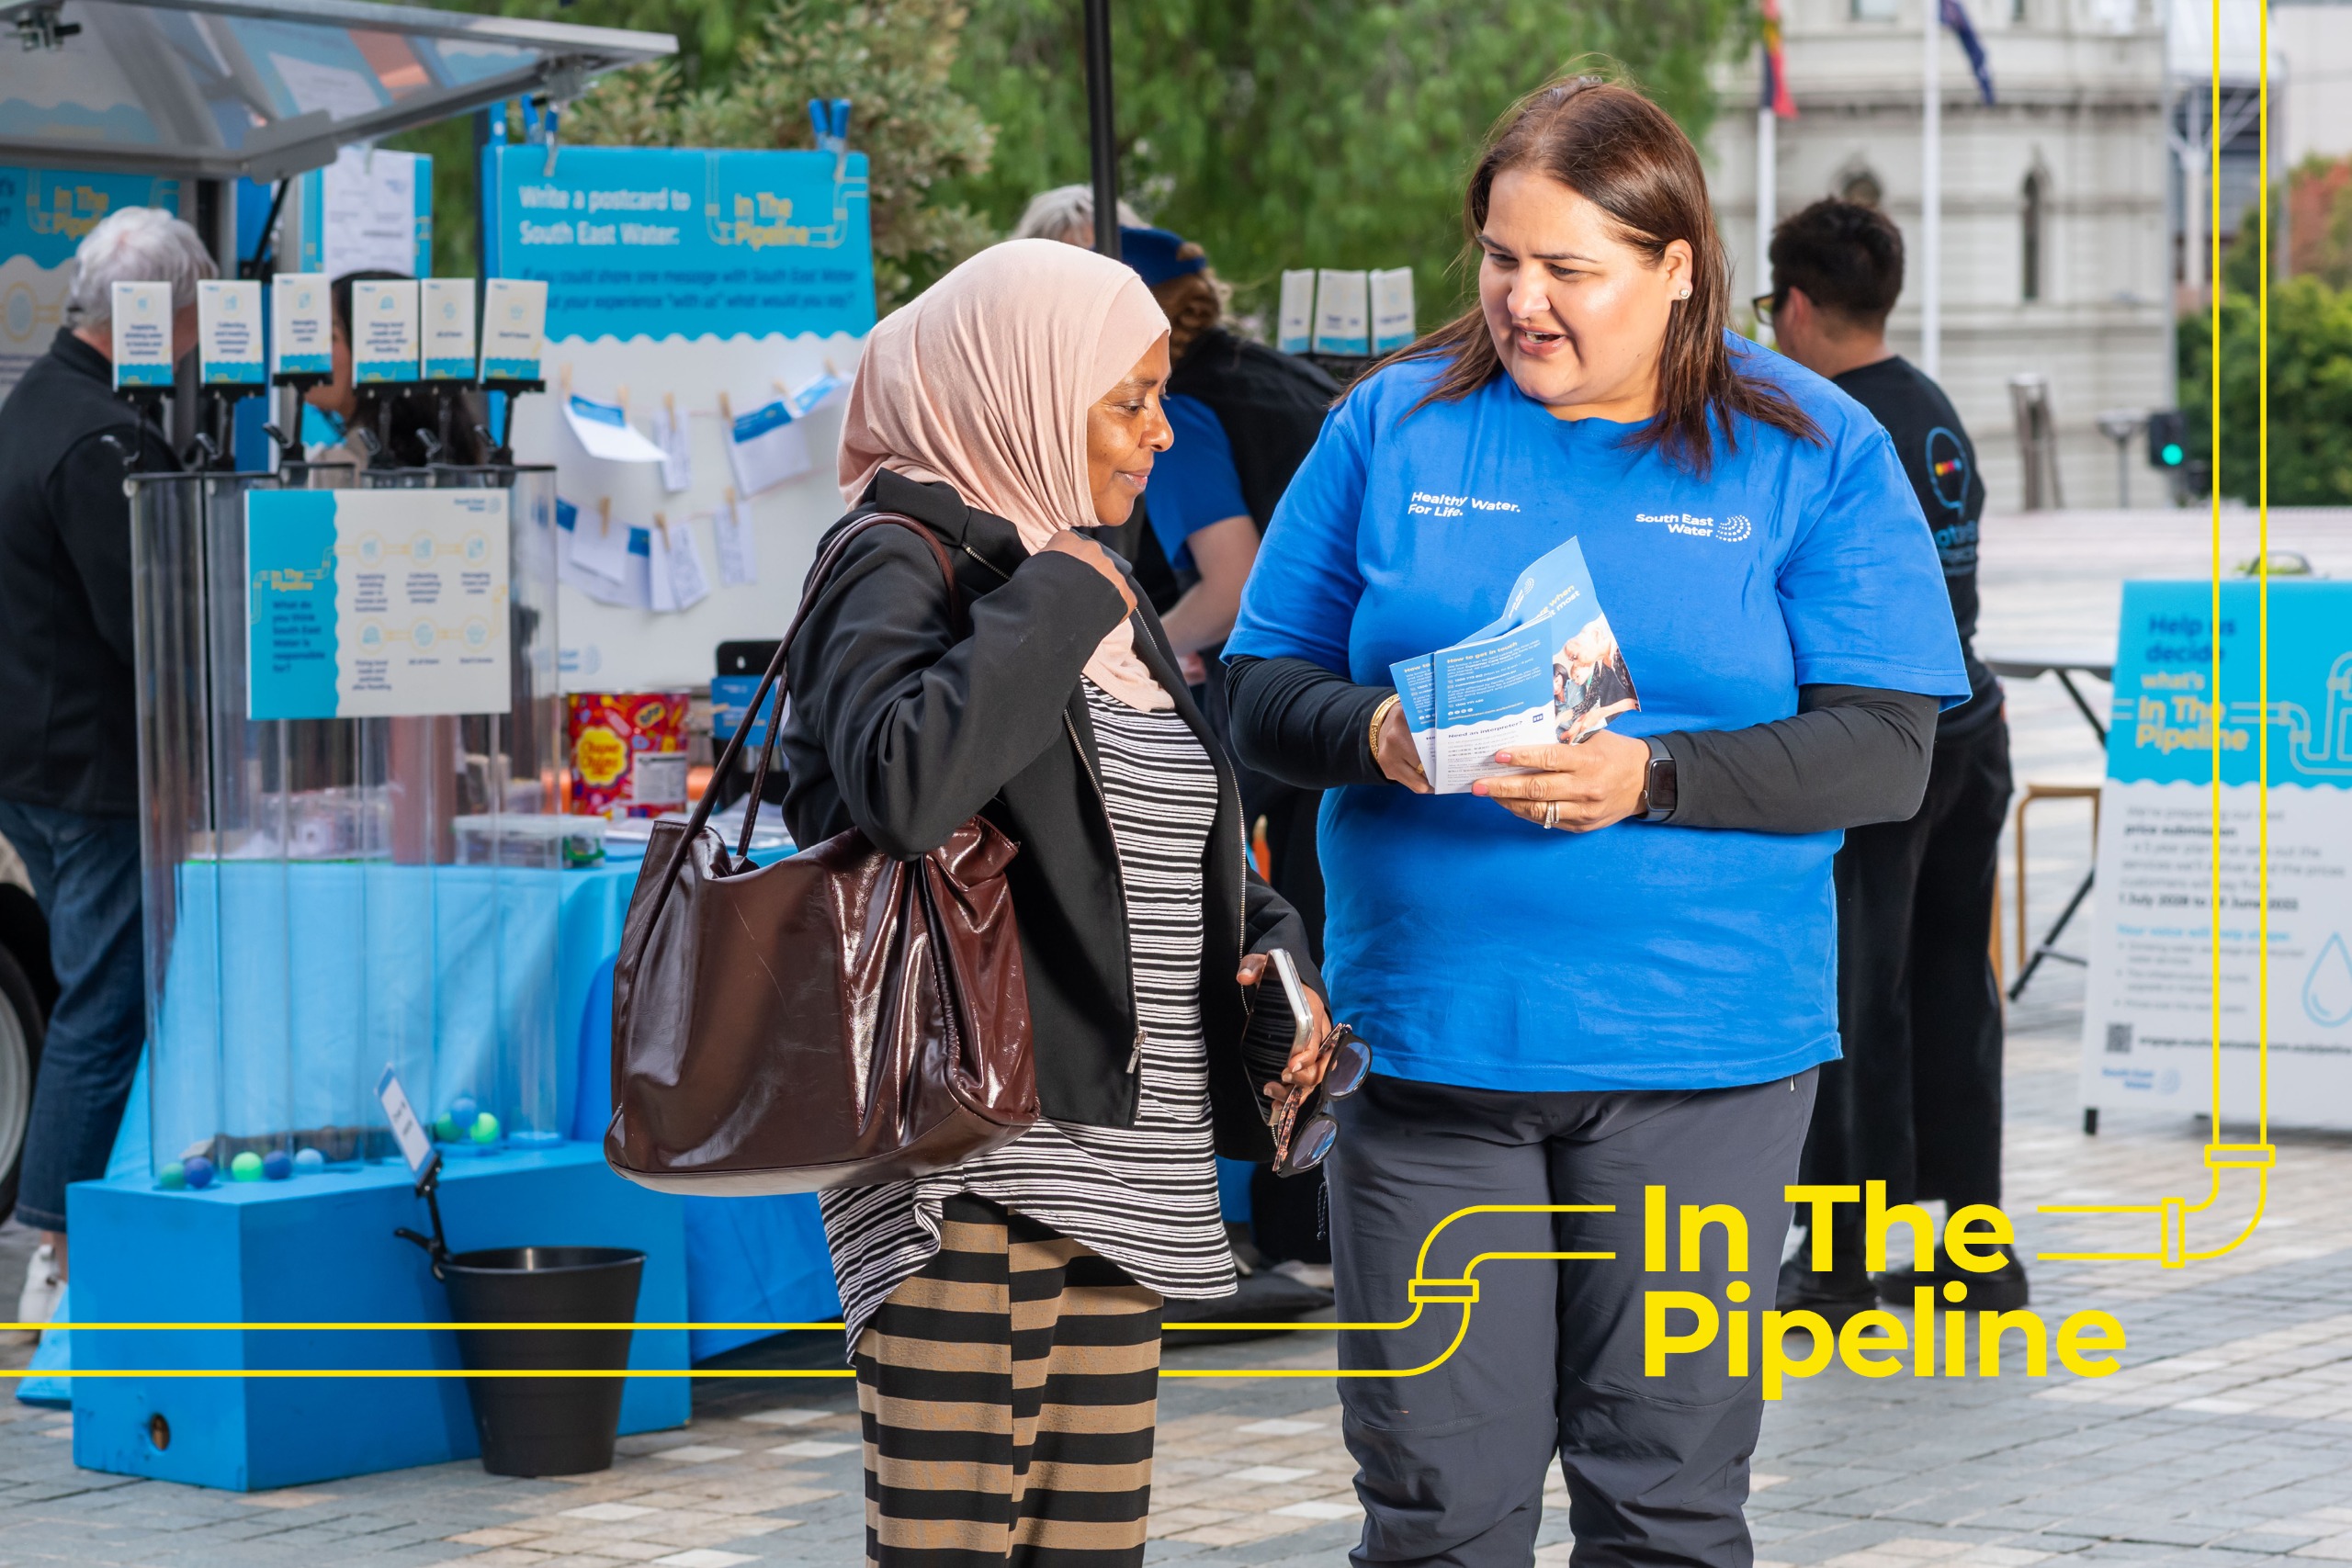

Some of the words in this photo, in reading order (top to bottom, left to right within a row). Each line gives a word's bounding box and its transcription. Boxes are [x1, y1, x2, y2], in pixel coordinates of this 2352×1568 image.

[518, 185, 569, 209] Write
[573, 191, 585, 209] a
[588, 187, 667, 214] postcard
[671, 189, 690, 211] to
[735, 193, 753, 217] In
[756, 192, 793, 219] The
[519, 220, 573, 245] South
[577, 222, 616, 245] East
[735, 221, 809, 251] Pipeline
[1408, 503, 1431, 514] For
[1434, 506, 1464, 517] Life.
[1411, 491, 1468, 506] Healthy
[1471, 497, 1521, 513] Water.
[1635, 513, 1679, 523] South
[1682, 513, 1713, 526] East
[1668, 524, 1713, 536] Water
[1549, 584, 1575, 606] when
[1556, 590, 1580, 611] most
[2148, 616, 2202, 637] Help
[1498, 641, 1517, 652] touch
[2141, 671, 2205, 691] what's
[2138, 695, 2165, 719] In
[2171, 695, 2225, 722] The
[1480, 720, 1523, 734] interpreter?
[2135, 723, 2249, 755] Pipeline
